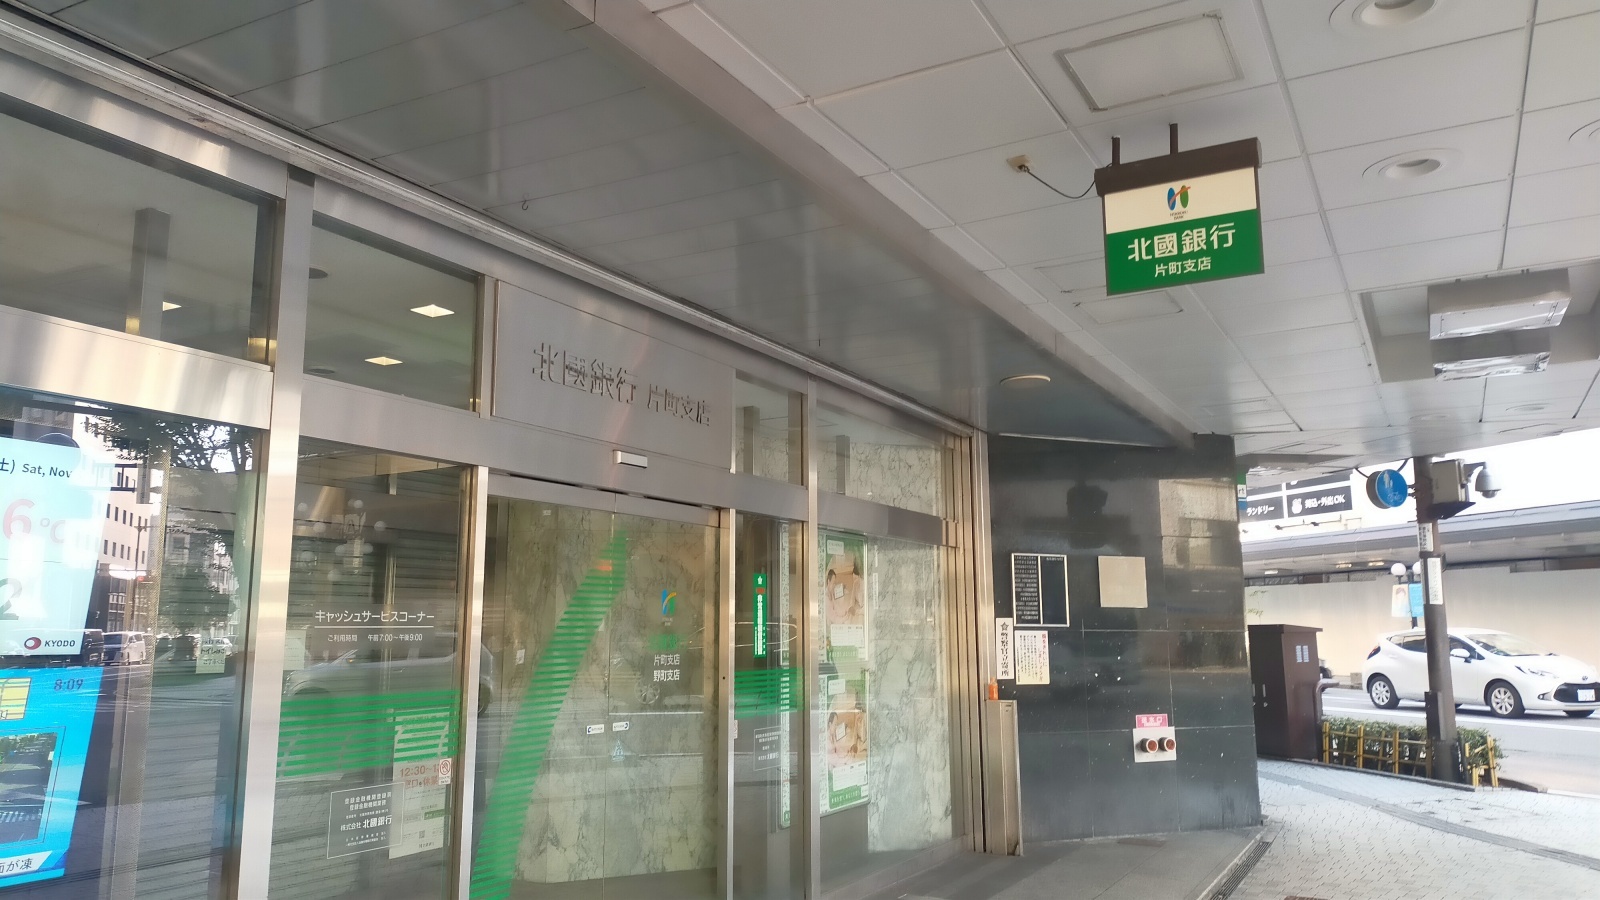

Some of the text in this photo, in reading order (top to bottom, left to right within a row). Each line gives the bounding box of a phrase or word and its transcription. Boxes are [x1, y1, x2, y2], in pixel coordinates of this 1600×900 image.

[1128, 223, 1236, 262] 北國銀行
[1154, 257, 1212, 278] 片町支店
[531, 342, 711, 427] 北國銀行 片町支店
[314, 609, 435, 622] キャッシュサービスコーナー
[44, 639, 76, 648] KYODO
[653, 654, 680, 666] 片町支店
[653, 669, 680, 682] 野町支店
[54, 679, 84, 691] 8:09
[362, 815, 392, 829] 北國銀行
